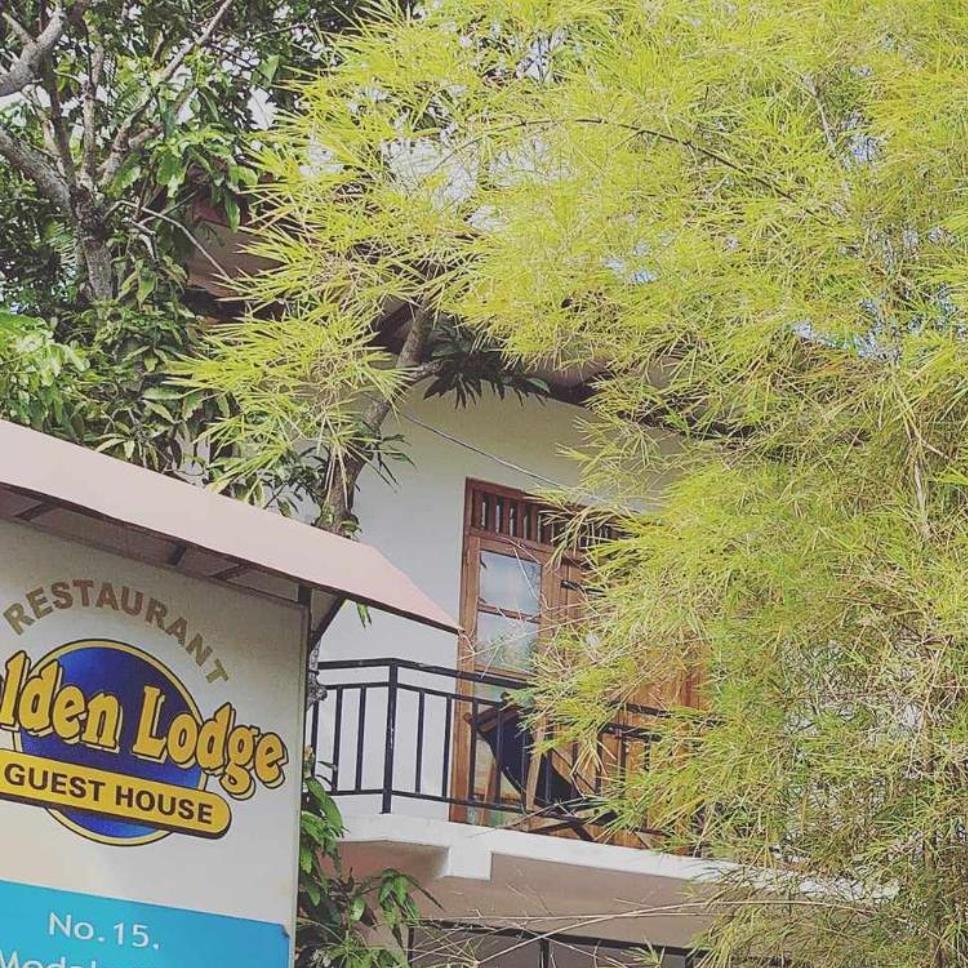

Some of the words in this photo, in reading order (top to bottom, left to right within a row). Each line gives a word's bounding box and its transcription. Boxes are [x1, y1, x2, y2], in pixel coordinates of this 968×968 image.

[3, 579, 229, 684] RESTAURANT
[0, 650, 122, 752] lden
[132, 685, 289, 800] Lodge
[4, 763, 105, 801] GUEST
[115, 785, 213, 825] HOUSE
